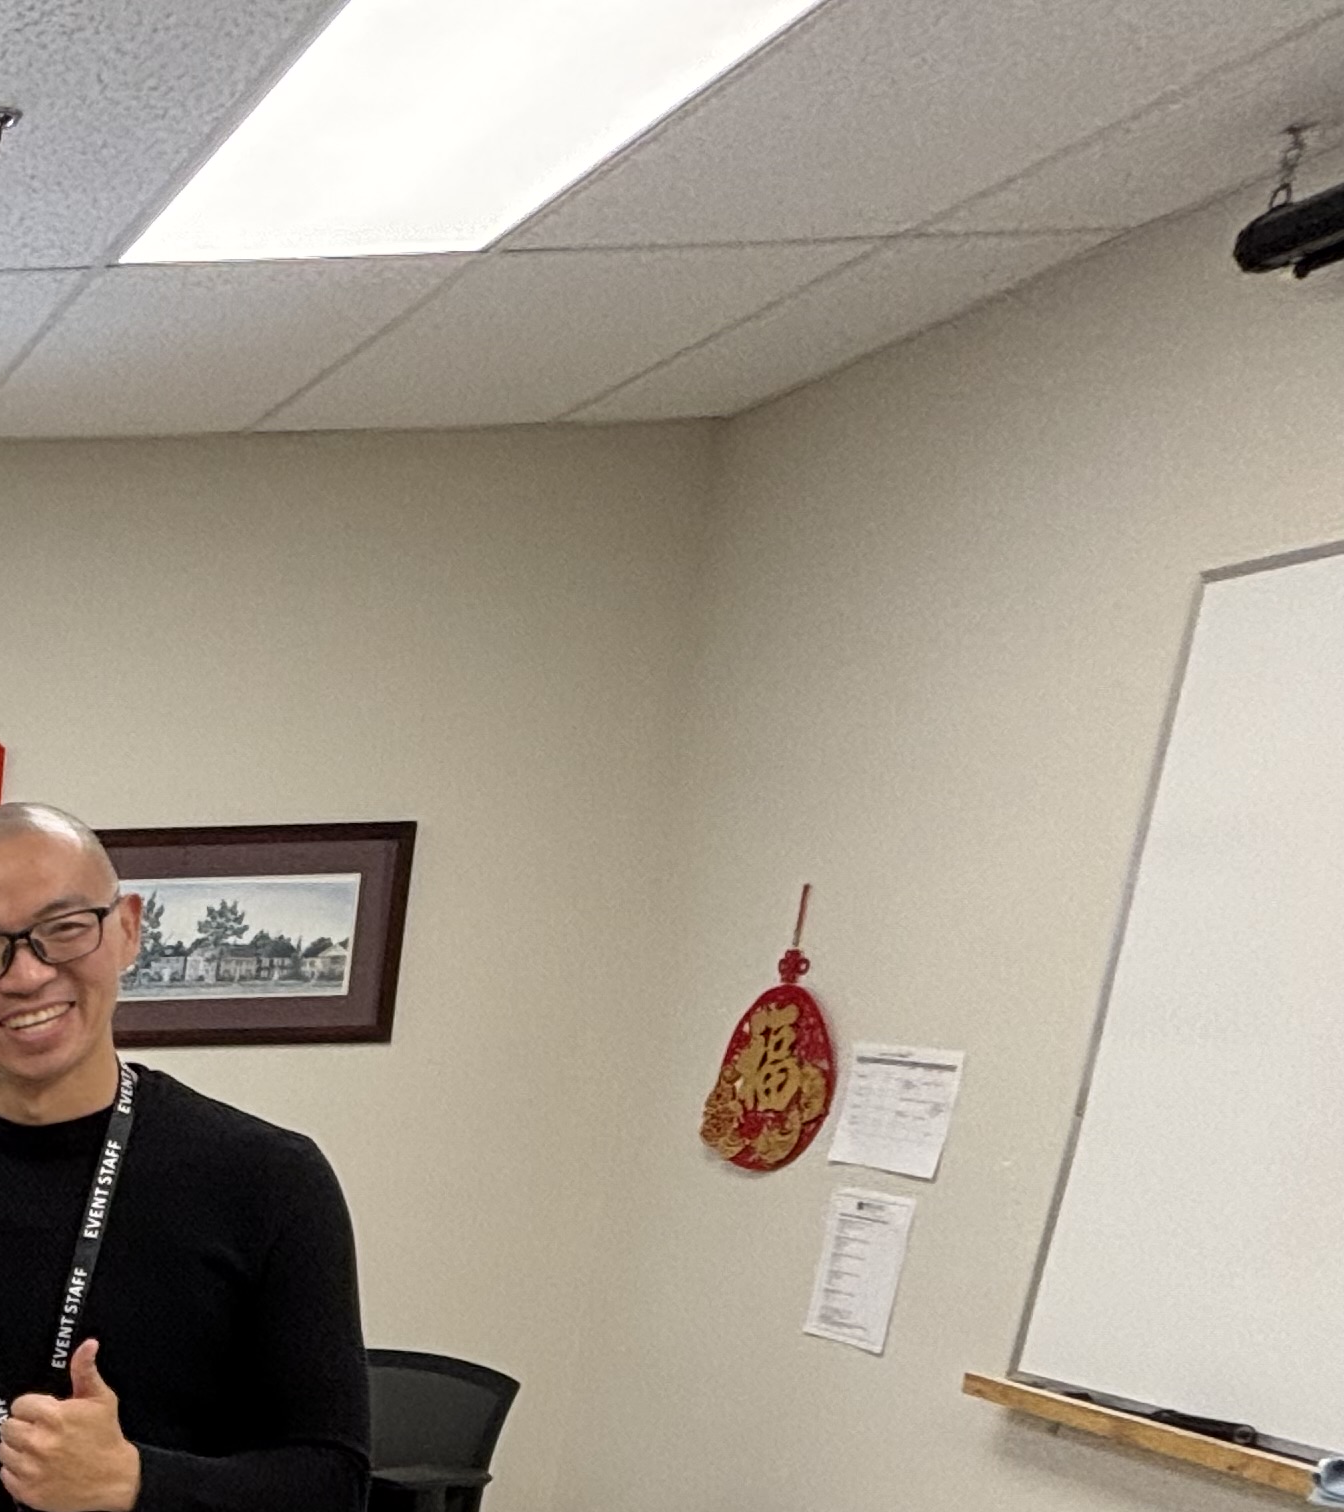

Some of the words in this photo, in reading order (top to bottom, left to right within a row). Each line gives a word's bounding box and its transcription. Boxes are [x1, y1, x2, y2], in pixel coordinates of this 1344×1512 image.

[83, 1187, 110, 1239] EVENT
[98, 1139, 122, 1185] STAFF
[51, 1315, 75, 1369] EVENT
[64, 1267, 88, 1314] STAFF
